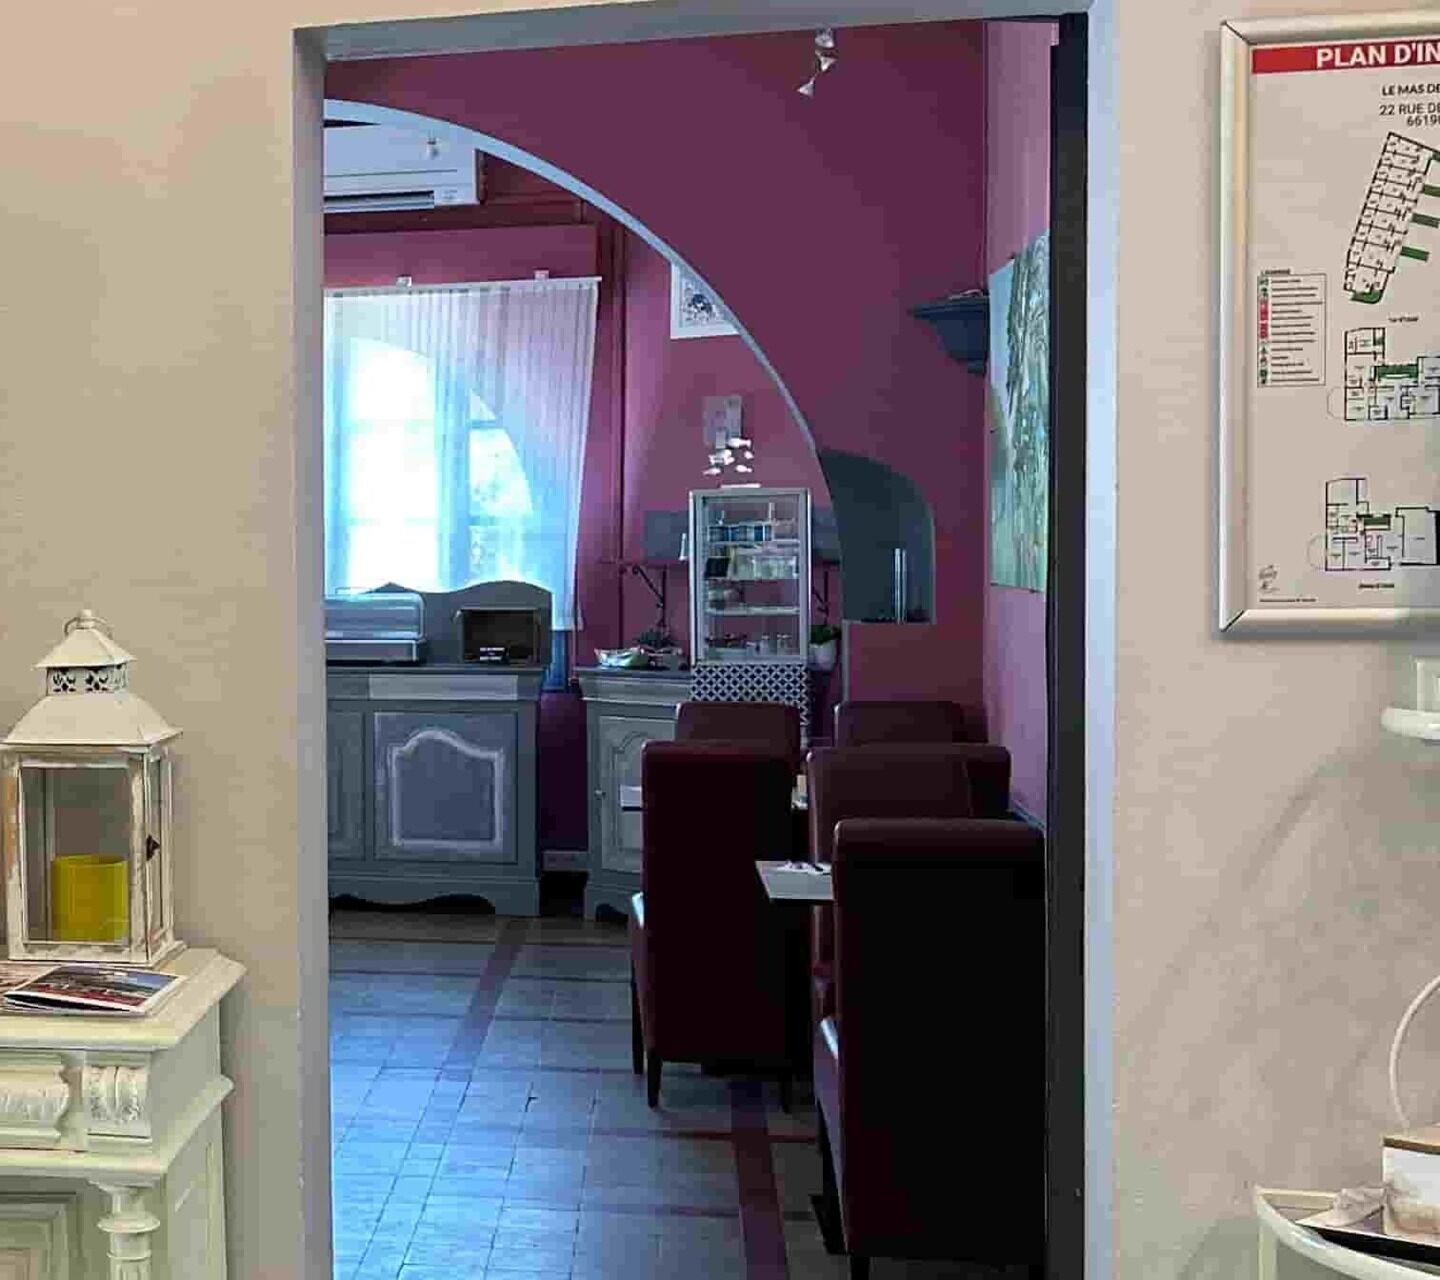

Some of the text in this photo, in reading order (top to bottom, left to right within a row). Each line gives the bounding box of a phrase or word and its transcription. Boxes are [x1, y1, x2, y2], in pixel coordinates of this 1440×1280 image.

[1316, 45, 1387, 68] PLAN
[1382, 85, 1396, 96] LE
[1398, 84, 1425, 95] MAS
[1379, 104, 1395, 116] 22
[1399, 103, 1425, 115] RUE
